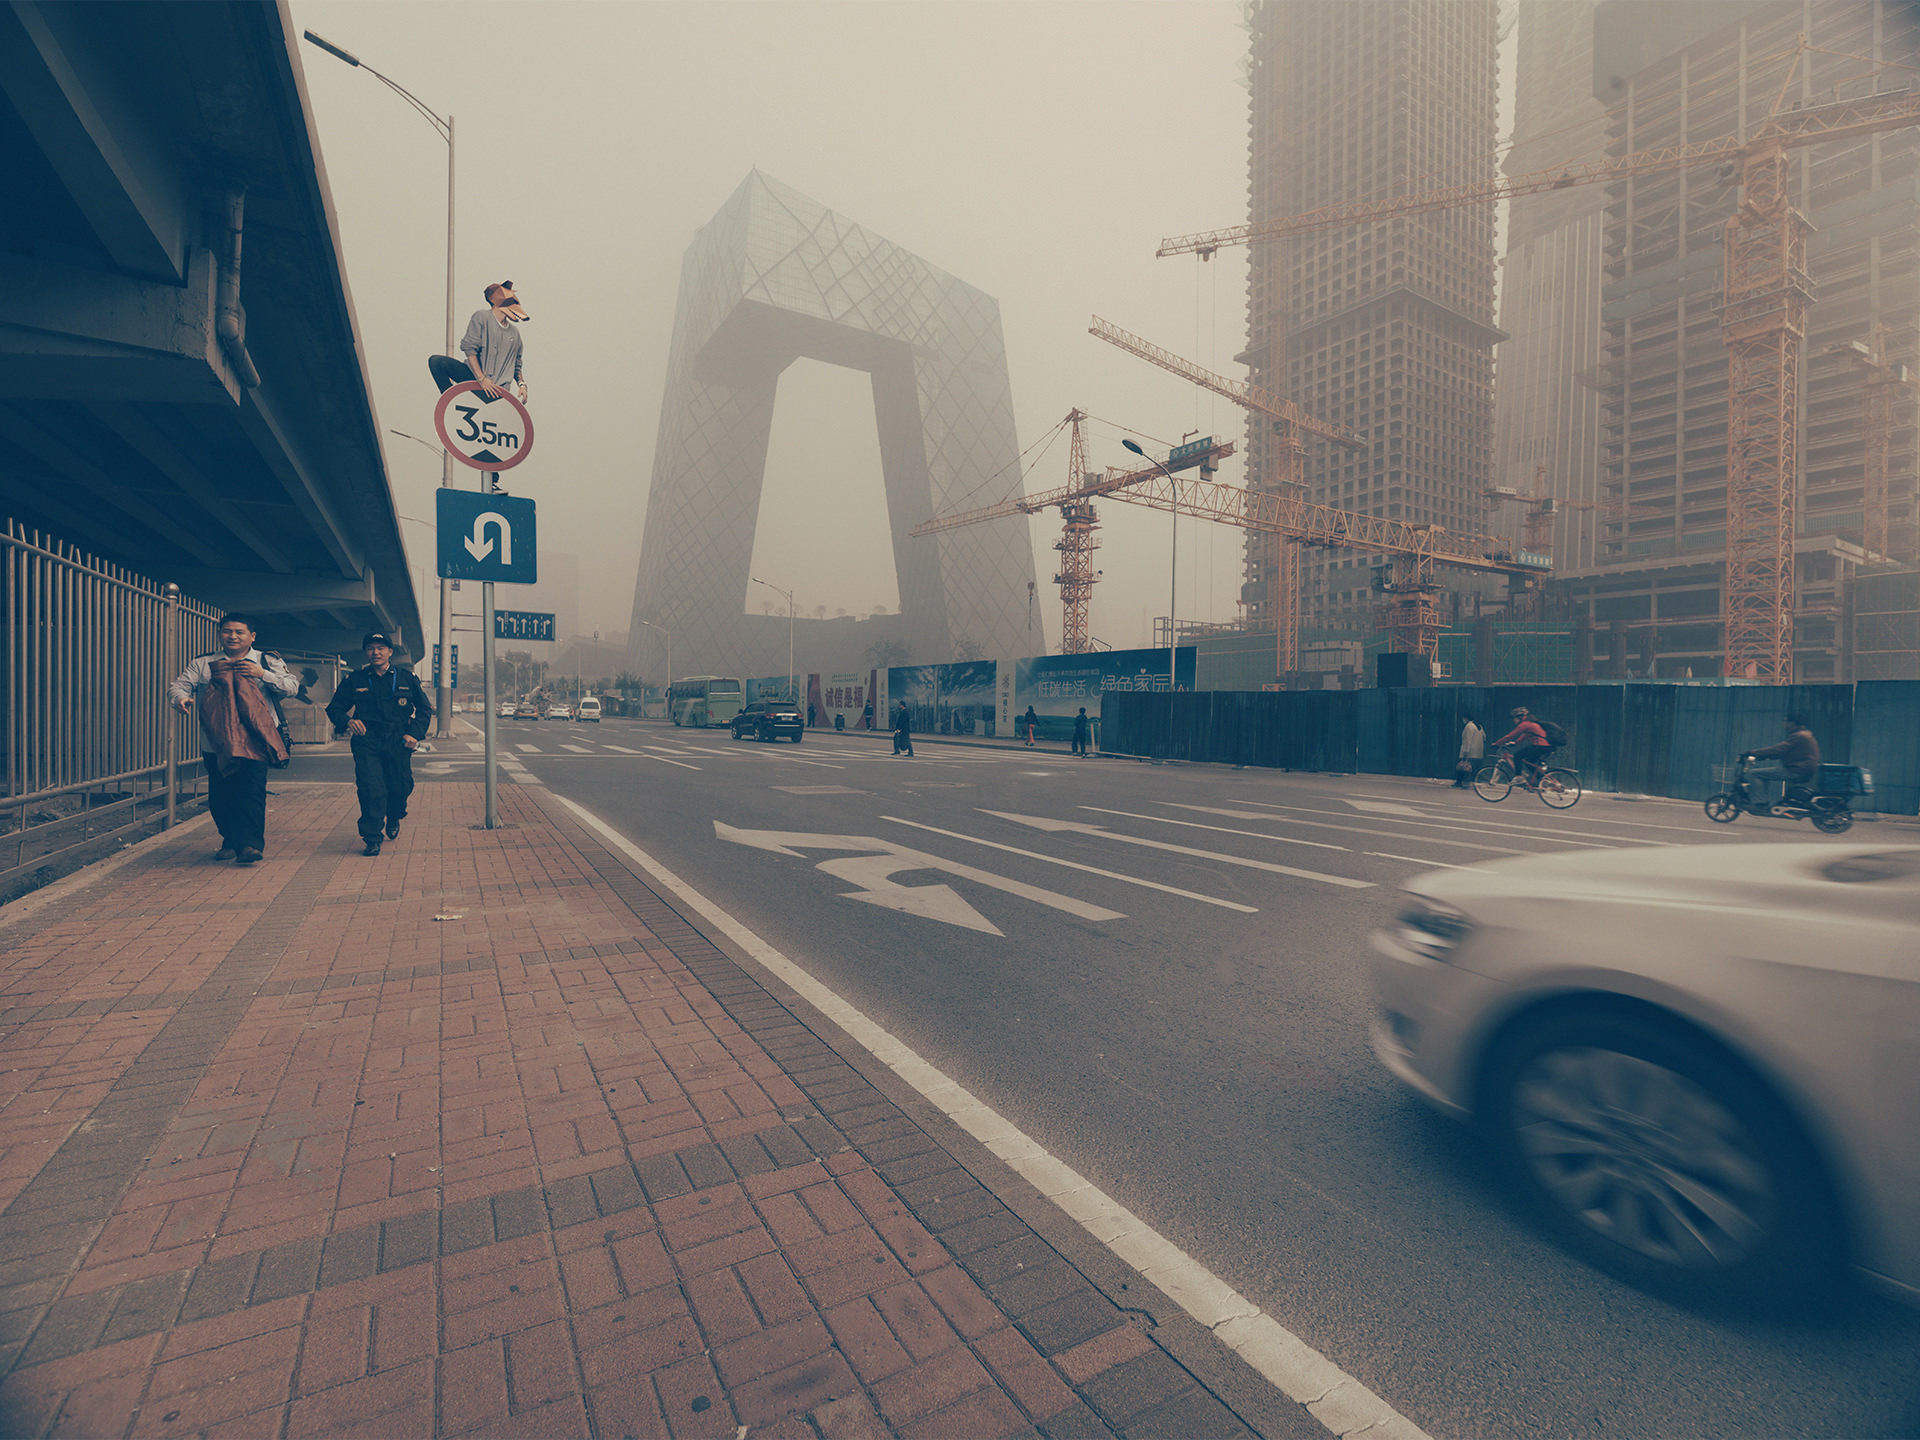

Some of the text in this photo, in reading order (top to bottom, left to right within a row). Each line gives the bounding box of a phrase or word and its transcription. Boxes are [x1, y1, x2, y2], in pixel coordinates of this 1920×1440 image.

[455, 404, 518, 449] 3.5m
[825, 686, 864, 709] 诚信是福
[1037, 679, 1086, 699] 低碳生活
